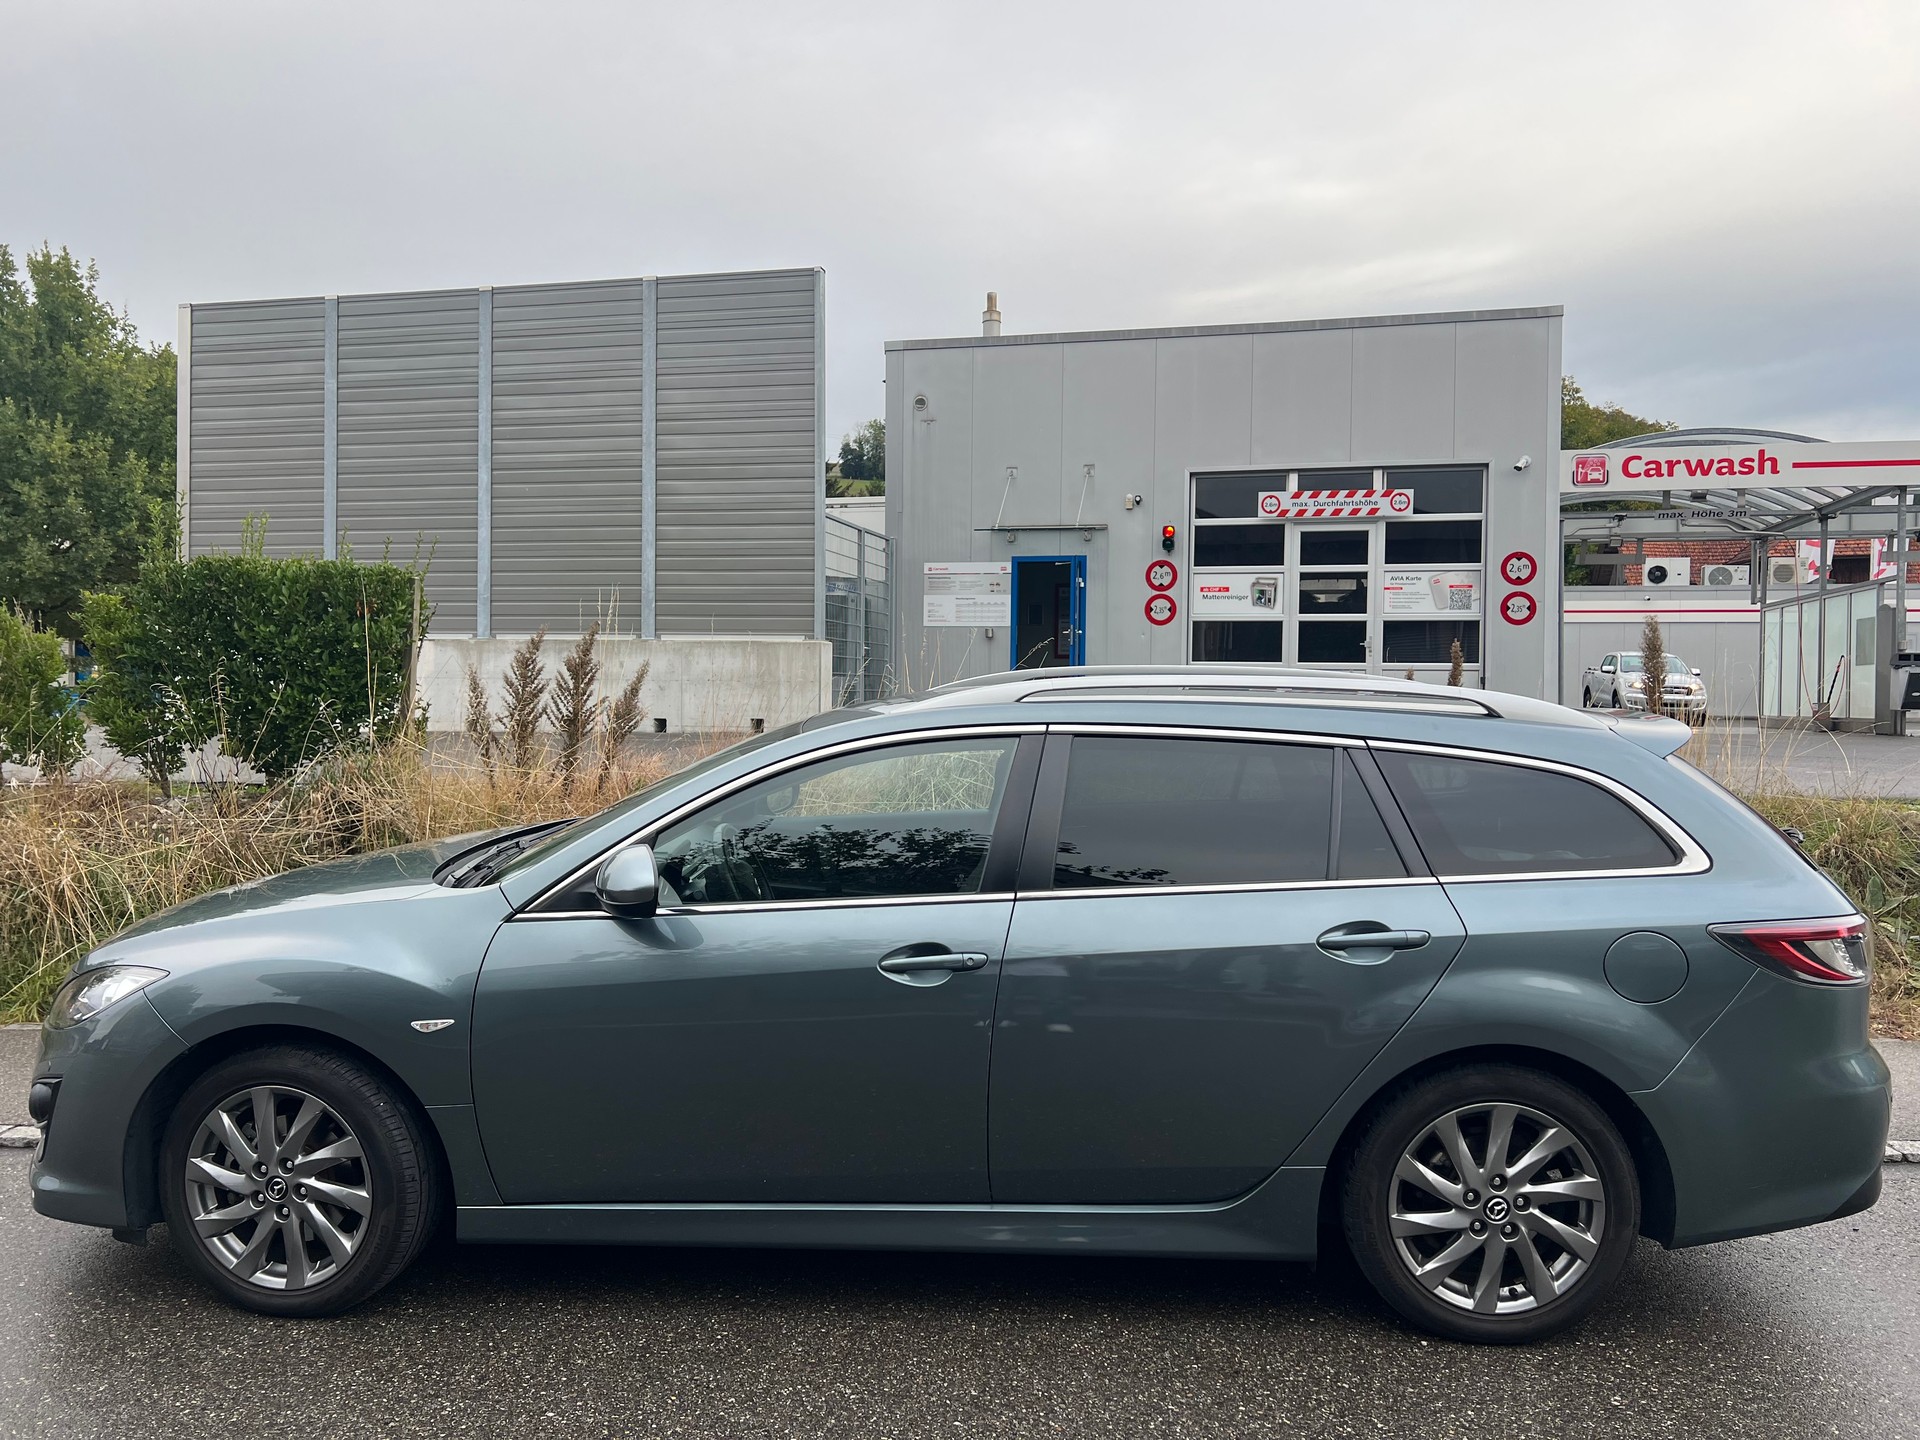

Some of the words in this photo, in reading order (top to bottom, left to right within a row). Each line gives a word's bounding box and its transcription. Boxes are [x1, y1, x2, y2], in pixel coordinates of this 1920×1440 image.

[1621, 449, 1780, 479] Carwash
[1313, 499, 1379, 507] Durchfahrtshöhe
[1658, 510, 1686, 519] max.
[1690, 509, 1723, 518] Höhe
[1727, 509, 1748, 518] 3m
